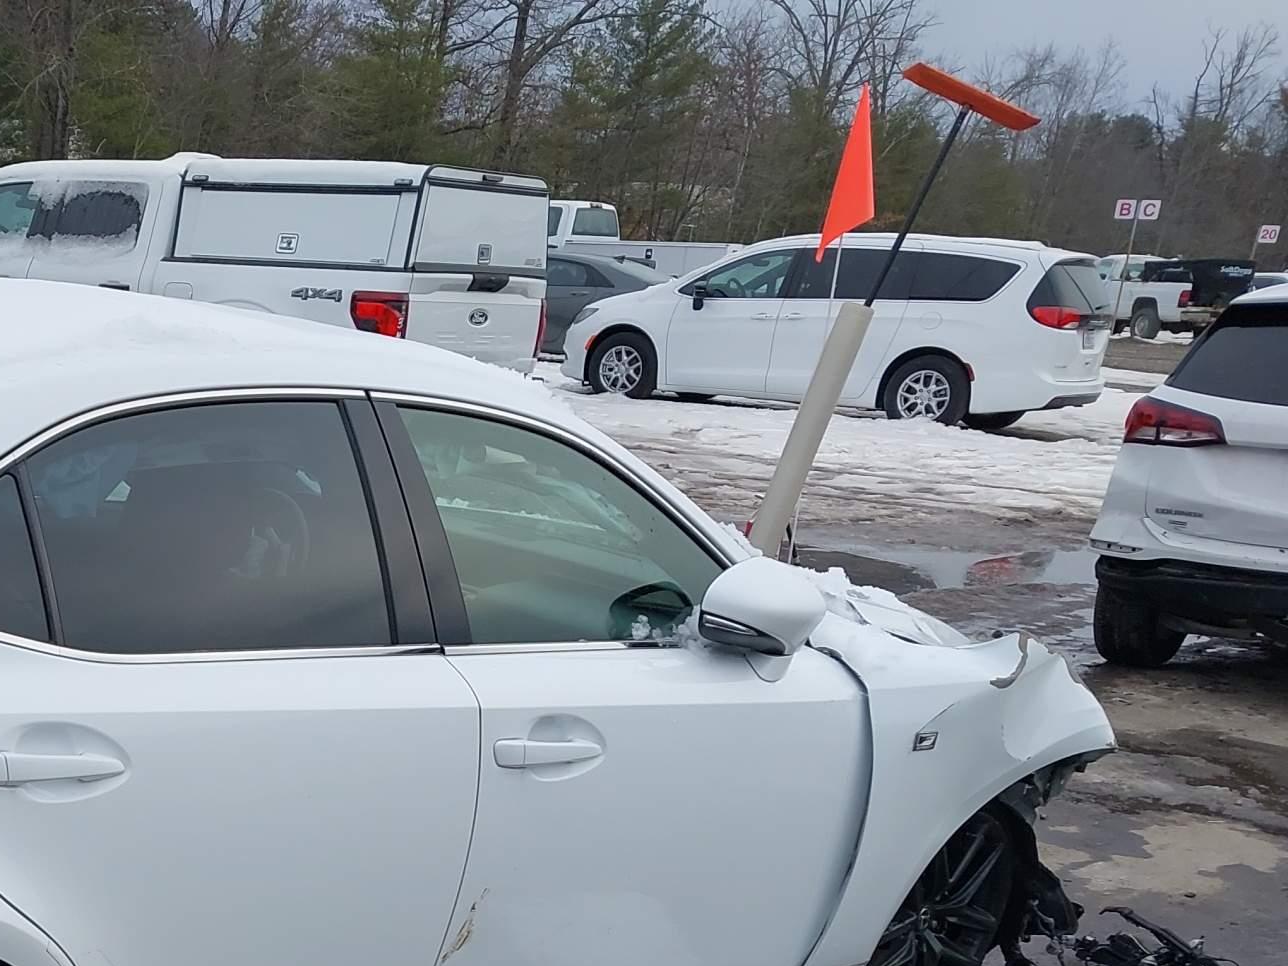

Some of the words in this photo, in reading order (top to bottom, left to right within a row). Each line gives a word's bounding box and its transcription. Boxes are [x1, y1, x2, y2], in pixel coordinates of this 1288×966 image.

[1119, 203, 1131, 217] B
[1143, 203, 1156, 217] C
[1261, 229, 1277, 240] 20
